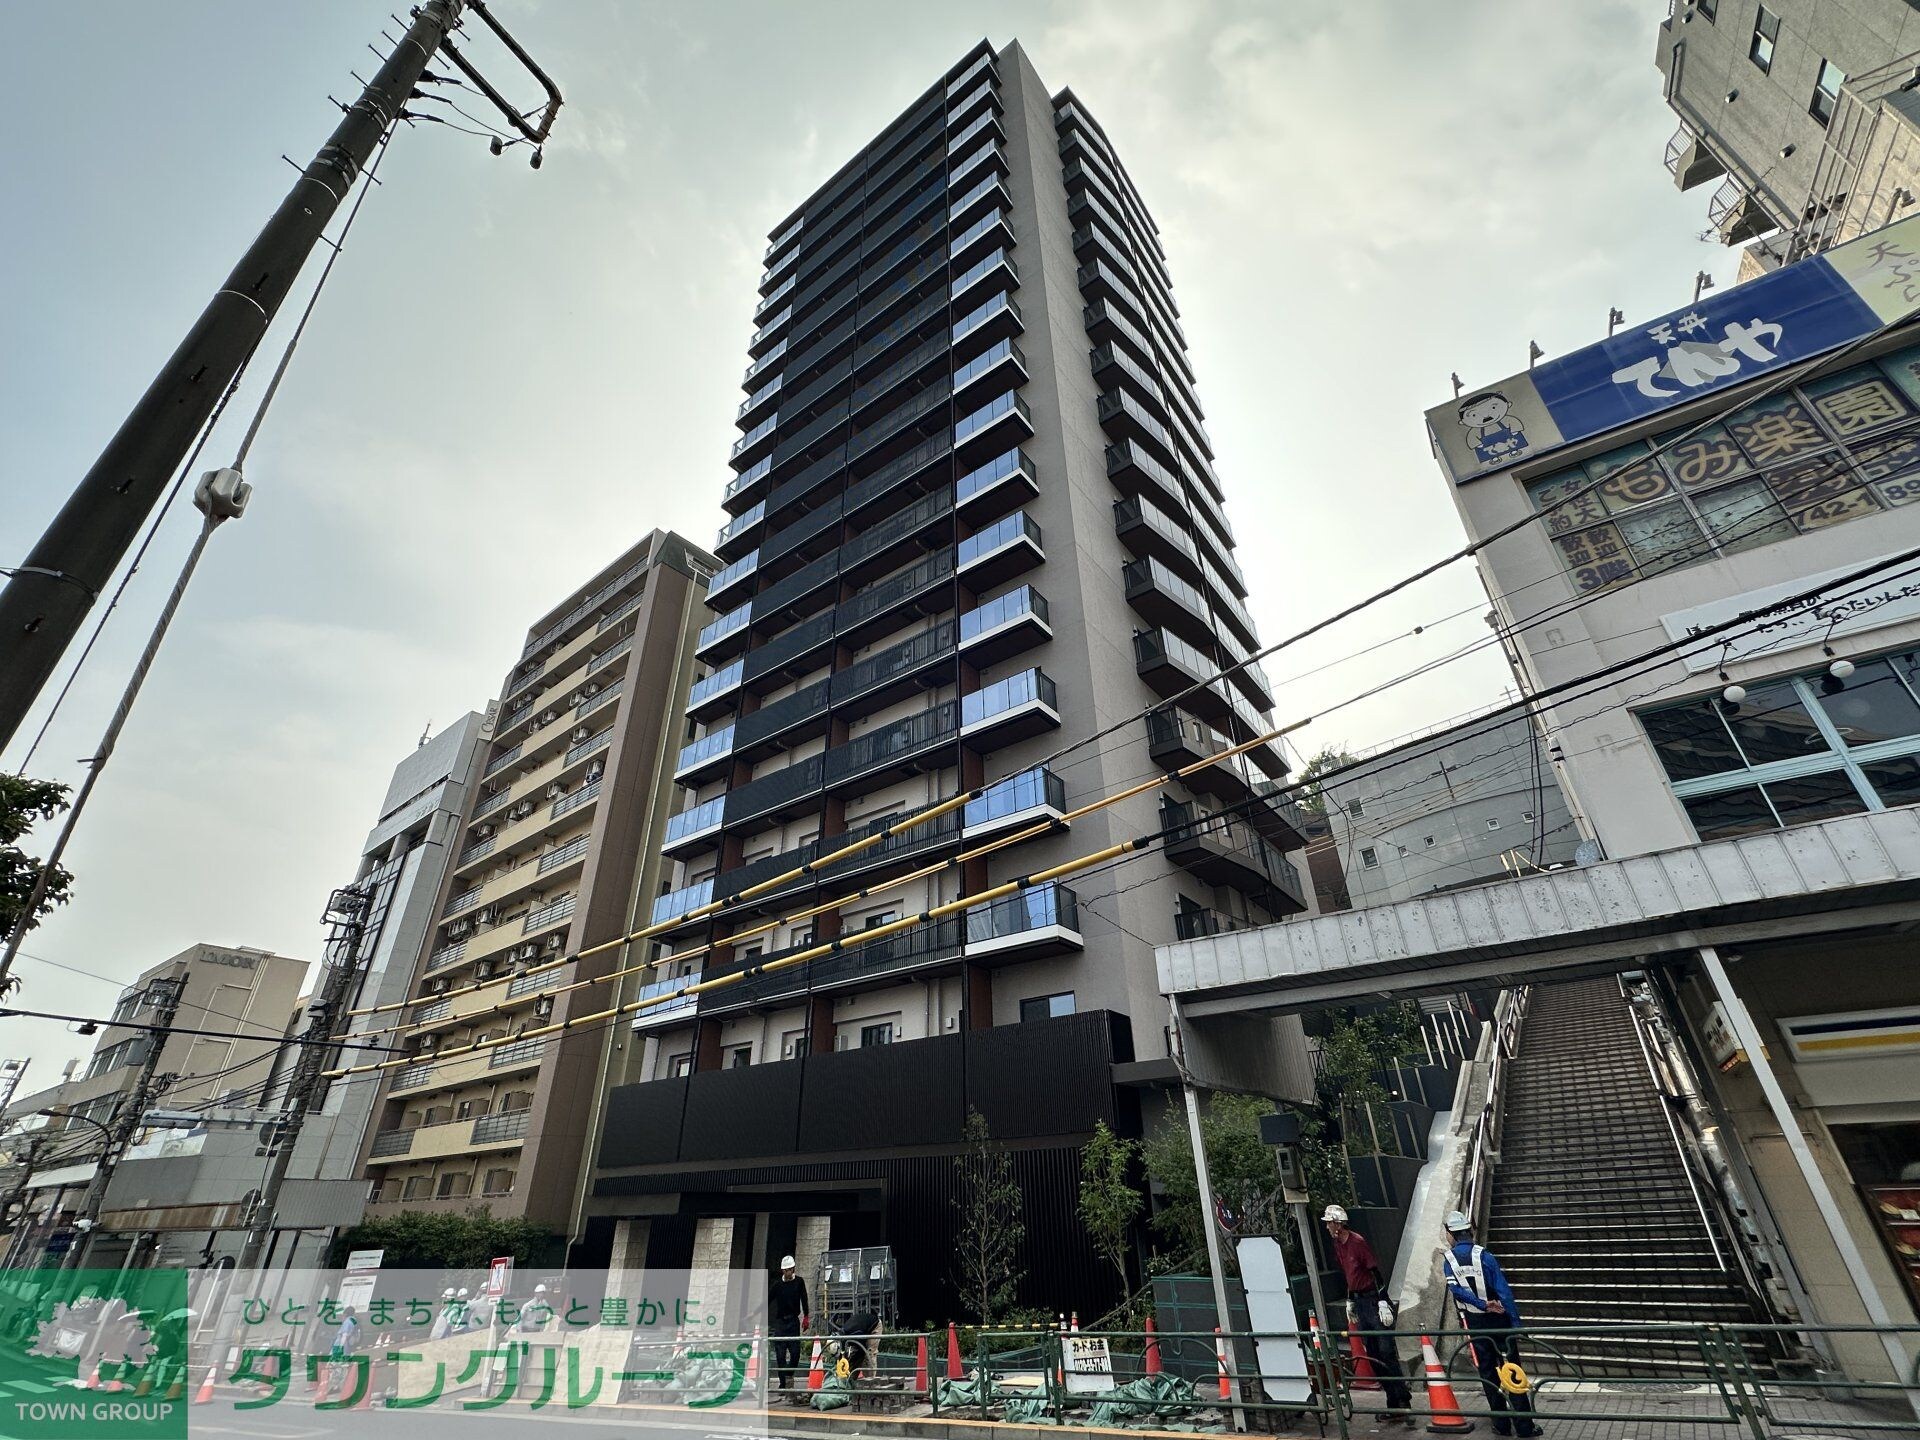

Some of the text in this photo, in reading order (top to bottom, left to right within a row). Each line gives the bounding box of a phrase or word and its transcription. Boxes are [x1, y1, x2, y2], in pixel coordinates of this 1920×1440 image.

[1612, 318, 1783, 397] てんや
[1647, 312, 1708, 344] 天丼
[1601, 378, 1909, 503] もみ楽園
